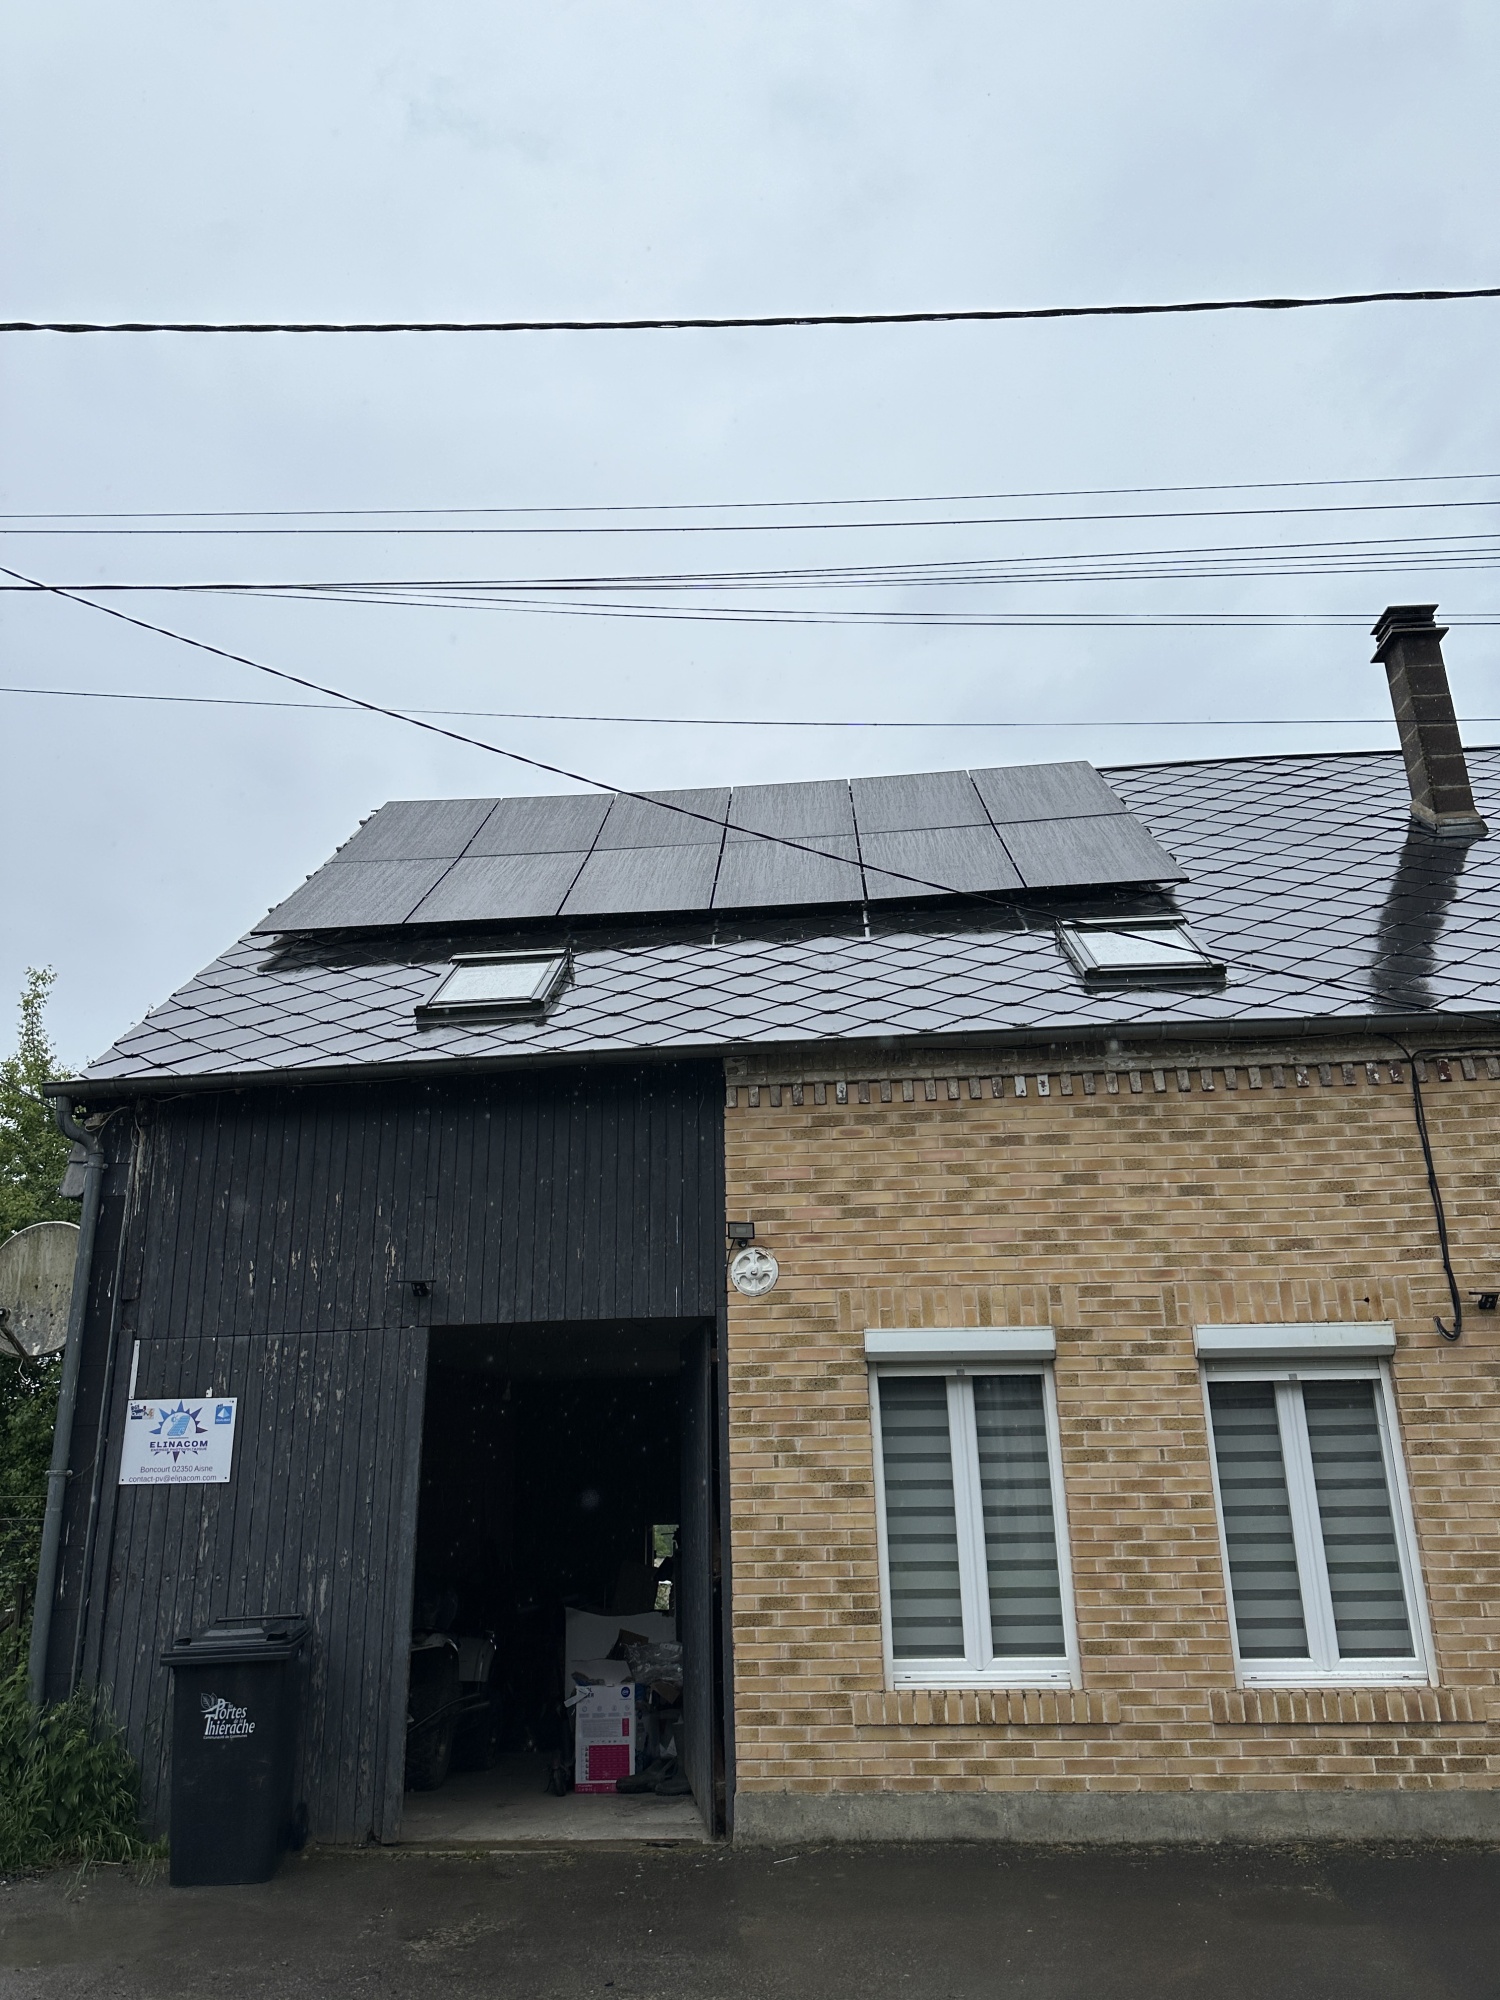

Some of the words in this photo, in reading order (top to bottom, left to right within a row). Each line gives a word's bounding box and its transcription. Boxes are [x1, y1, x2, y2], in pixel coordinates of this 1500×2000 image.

[149, 1440, 208, 1448] ELINACOM
[213, 1698, 247, 1719] Portes
[204, 1714, 255, 1735] Thiérache
